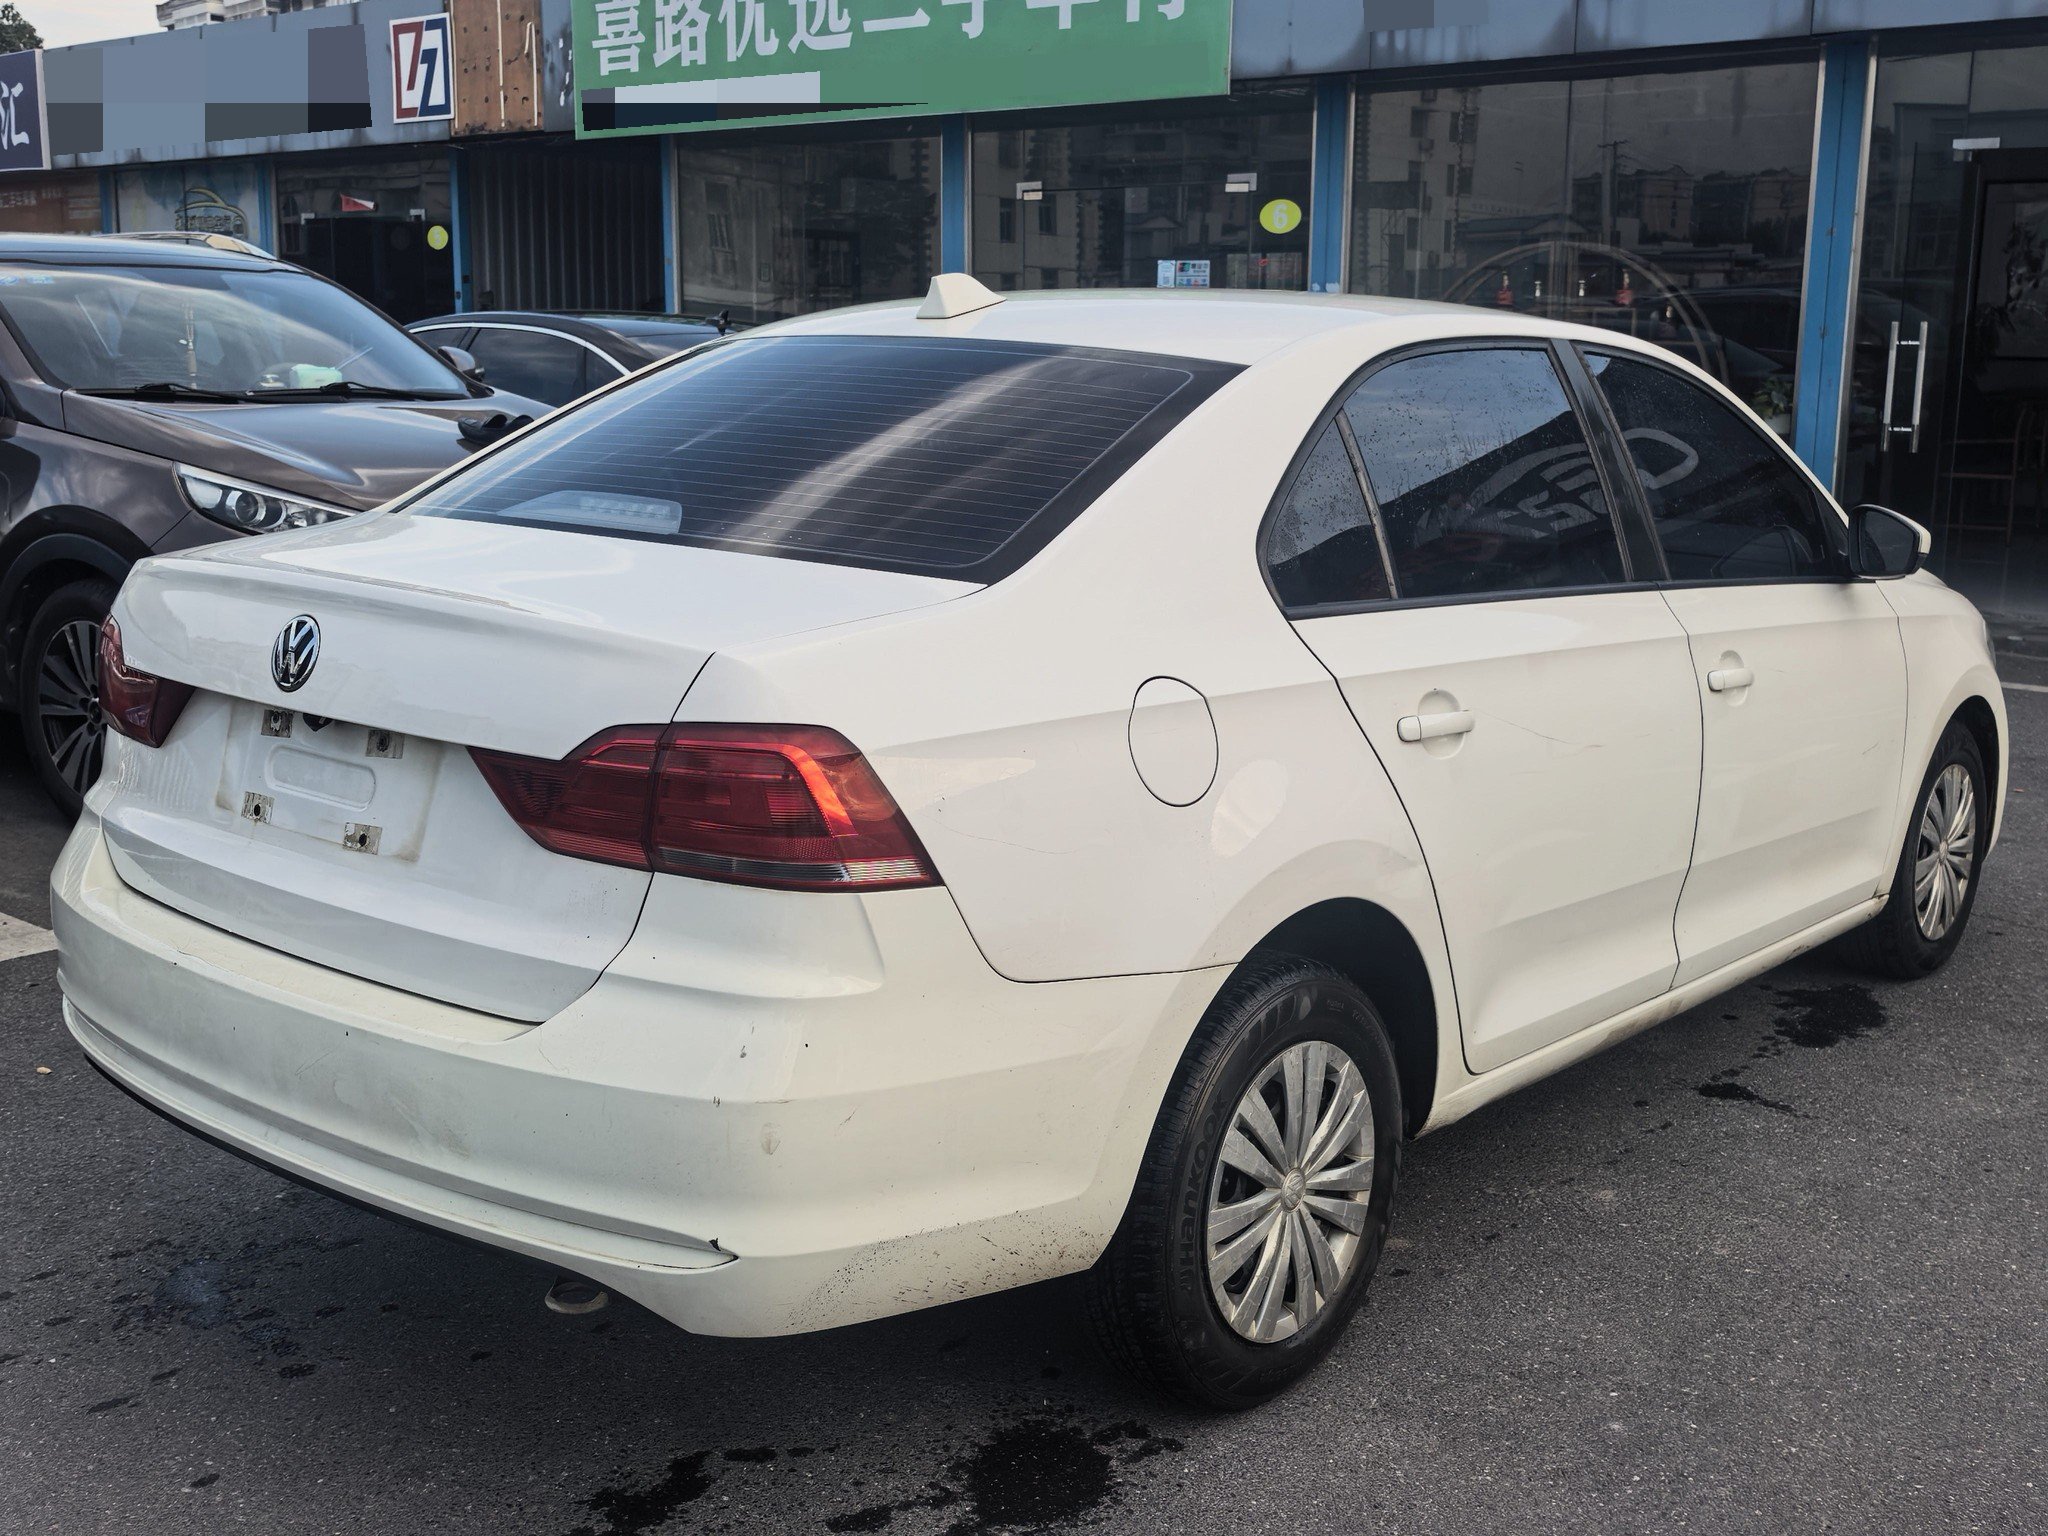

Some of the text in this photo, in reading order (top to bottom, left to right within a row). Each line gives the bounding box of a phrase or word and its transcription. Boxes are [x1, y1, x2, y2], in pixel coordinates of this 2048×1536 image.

[592, 0, 1185, 76] 喜路优选
[1273, 203, 1288, 229] 6
